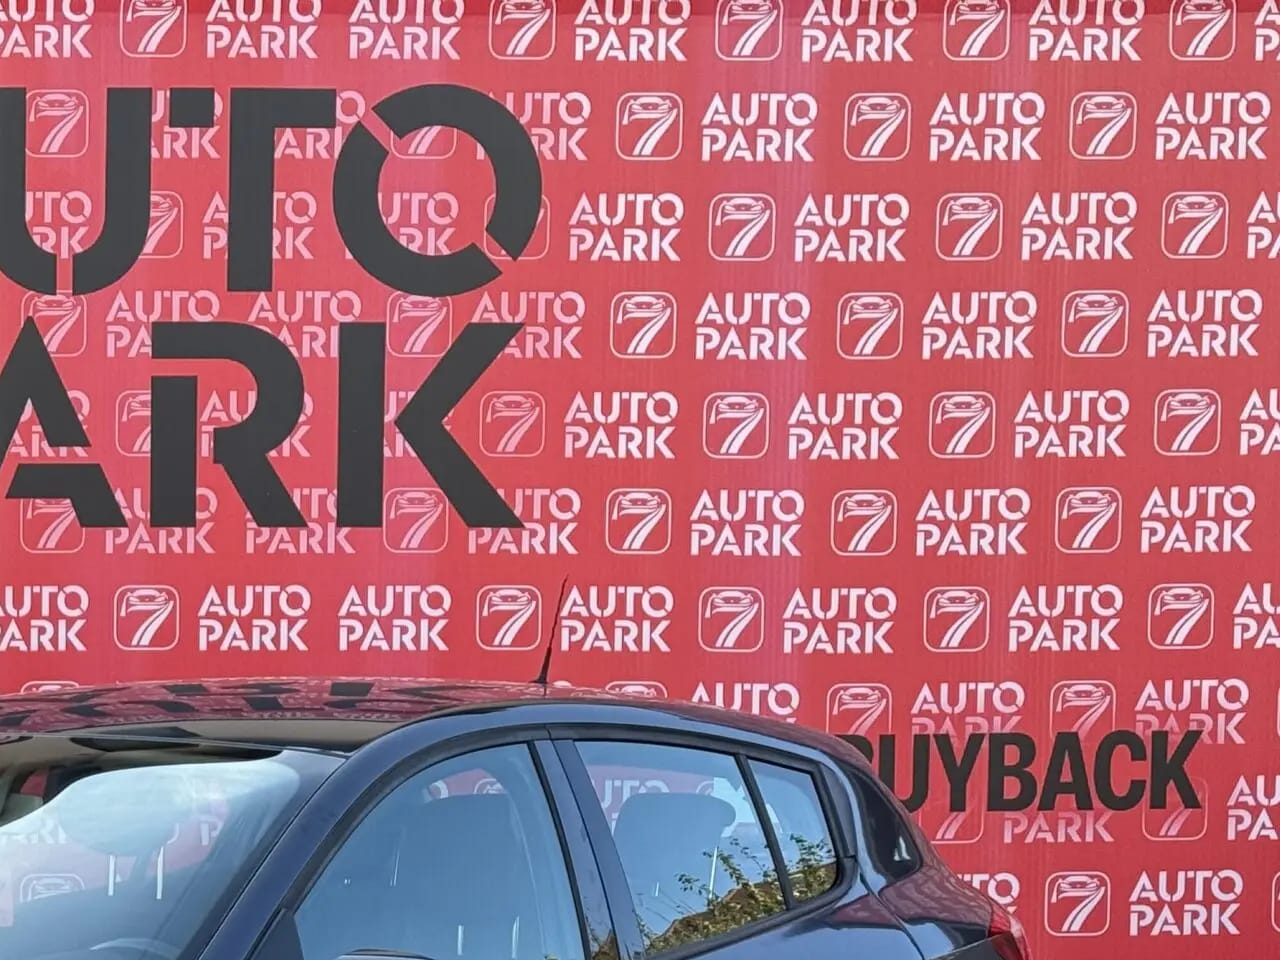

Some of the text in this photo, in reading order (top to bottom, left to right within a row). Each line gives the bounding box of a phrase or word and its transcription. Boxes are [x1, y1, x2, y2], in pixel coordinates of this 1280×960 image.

[205, 23, 319, 60] PARK
[349, 24, 461, 61] PARK
[574, 26, 688, 62] PARK
[800, 26, 914, 63] PARK
[1027, 25, 1143, 62] PARK
[701, 92, 818, 127] AUTO
[929, 91, 1045, 126] AUTO
[1155, 91, 1271, 125] AUTO
[701, 128, 814, 162] PARK
[929, 127, 1041, 161] PARK
[1155, 126, 1267, 160] PARK
[569, 192, 684, 226] AUTO
[794, 193, 910, 227] AUTO
[1021, 191, 1137, 225] AUTO
[569, 228, 681, 262] PARK
[794, 228, 906, 262] PARK
[1021, 226, 1133, 261] PARK
[106, 291, 220, 323] AUTO
[248, 291, 362, 323] AUTO
[470, 290, 586, 324] AUTO
[695, 292, 811, 326] AUTO
[921, 290, 1037, 325] AUTO
[1147, 288, 1263, 322] AUTO
[695, 326, 807, 360] PARK
[922, 325, 1034, 360] PARK
[1147, 323, 1259, 357] PARK
[564, 391, 679, 424] AUTO
[787, 392, 903, 425] AUTO
[1014, 389, 1130, 423] AUTO
[565, 425, 675, 459] PARK
[788, 427, 899, 460] PARK
[1014, 424, 1126, 458] PARK
[690, 489, 805, 522] AUTO
[915, 487, 1031, 521] AUTO
[1140, 485, 1256, 518] AUTO
[105, 523, 215, 555] PARK
[246, 523, 356, 555] PARK
[468, 523, 578, 555] PARK
[690, 523, 801, 557] PARK
[916, 522, 1027, 556] PARK
[1140, 519, 1252, 553] PARK
[198, 584, 311, 617] AUTO
[338, 584, 452, 617] AUTO
[559, 585, 674, 618] AUTO
[782, 587, 897, 620] AUTO
[1007, 584, 1123, 618] AUTO
[199, 618, 308, 651] PARK
[339, 618, 449, 651] PARK
[560, 619, 670, 652] PARK
[783, 621, 894, 654] PARK
[1008, 618, 1120, 652] PARK
[910, 681, 1025, 714] AUTO
[1134, 678, 1250, 711] AUTO
[1004, 811, 1115, 844] PARK
[1129, 869, 1244, 902] AUTO
[1129, 903, 1240, 936] PARK
